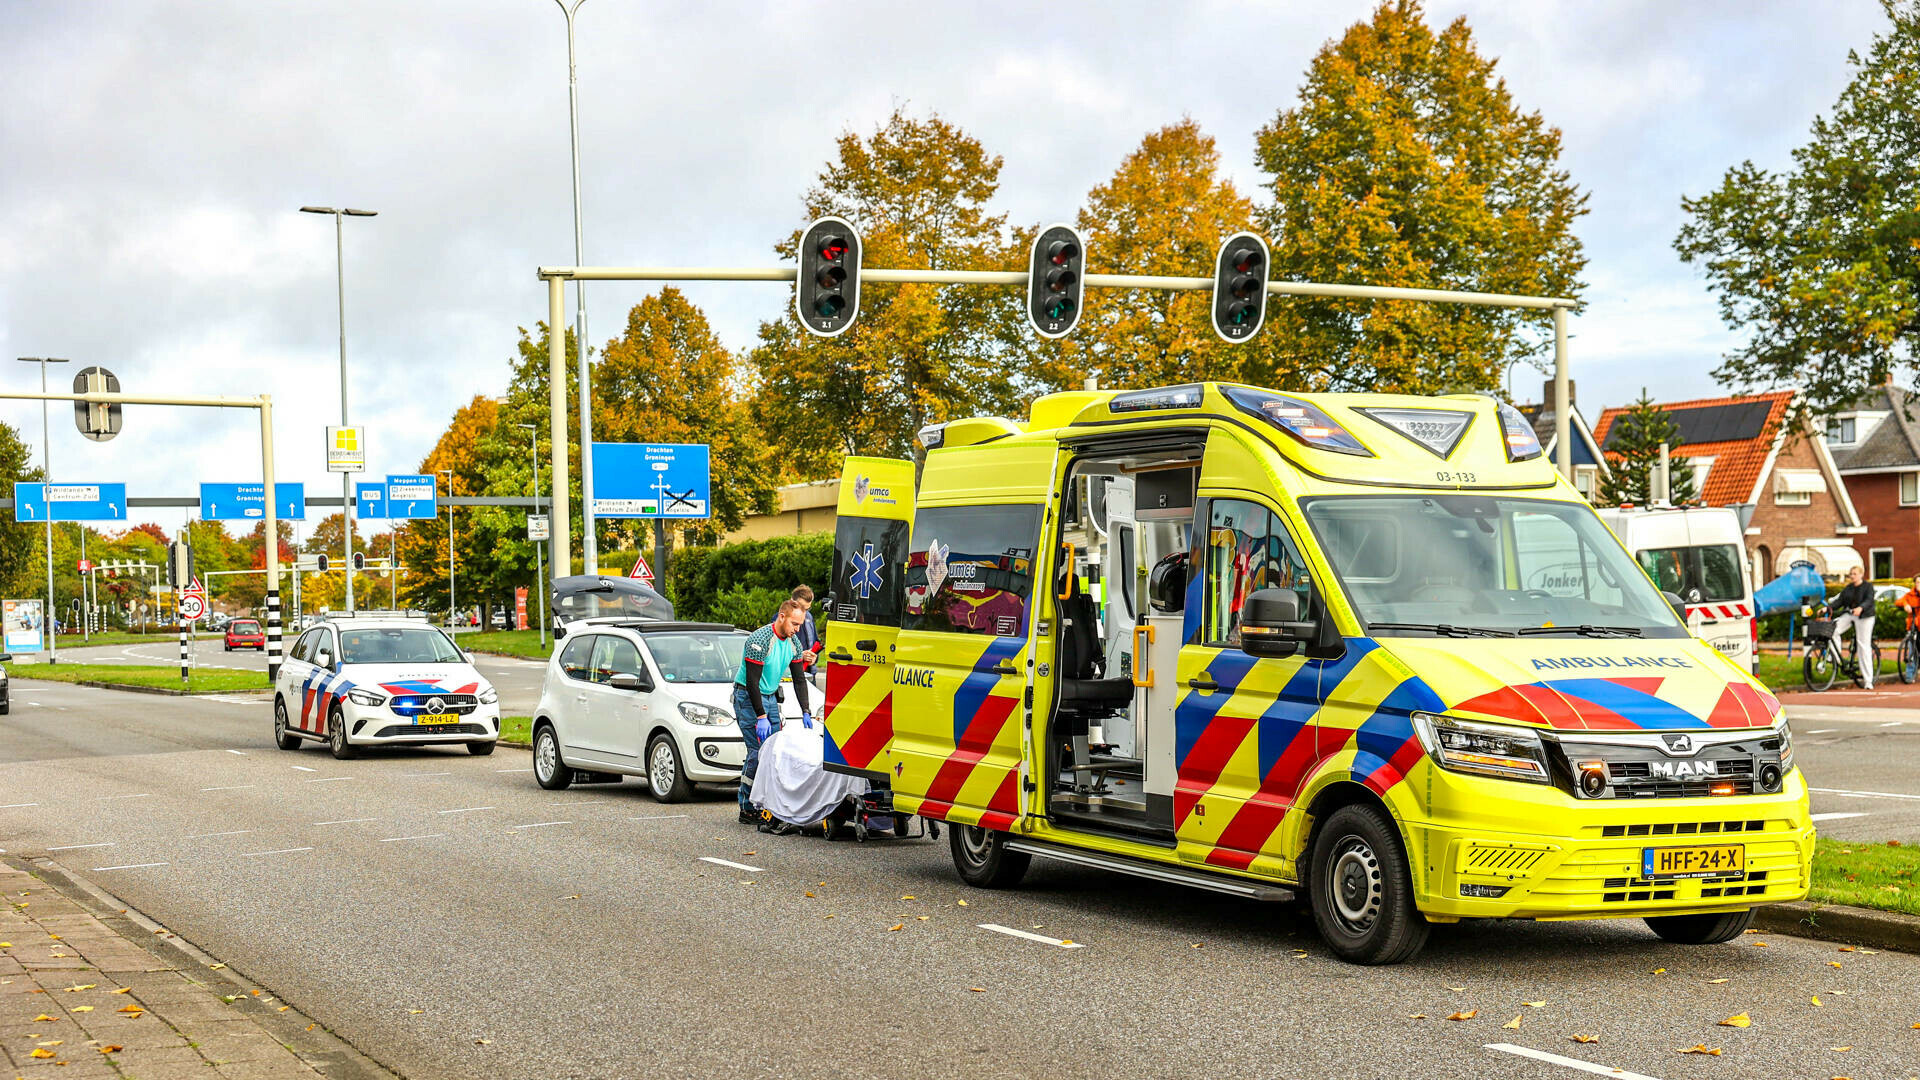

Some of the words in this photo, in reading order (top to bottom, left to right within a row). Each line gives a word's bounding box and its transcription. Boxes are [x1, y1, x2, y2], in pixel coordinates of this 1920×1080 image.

[644, 454, 676, 462] Groningen
[1436, 471, 1476, 483] 03-133
[236, 495, 266, 503] Groninge
[1541, 572, 1584, 589] Jonker
[184, 601, 200, 612] 30
[1713, 640, 1740, 651] Jonker
[862, 653, 886, 664] 03-133
[1531, 656, 1693, 670] AMBULANCE
[421, 715, 454, 724] Z-914-LZ
[1652, 761, 1715, 777] MAN
[1660, 848, 1737, 871] HFF-24-X
